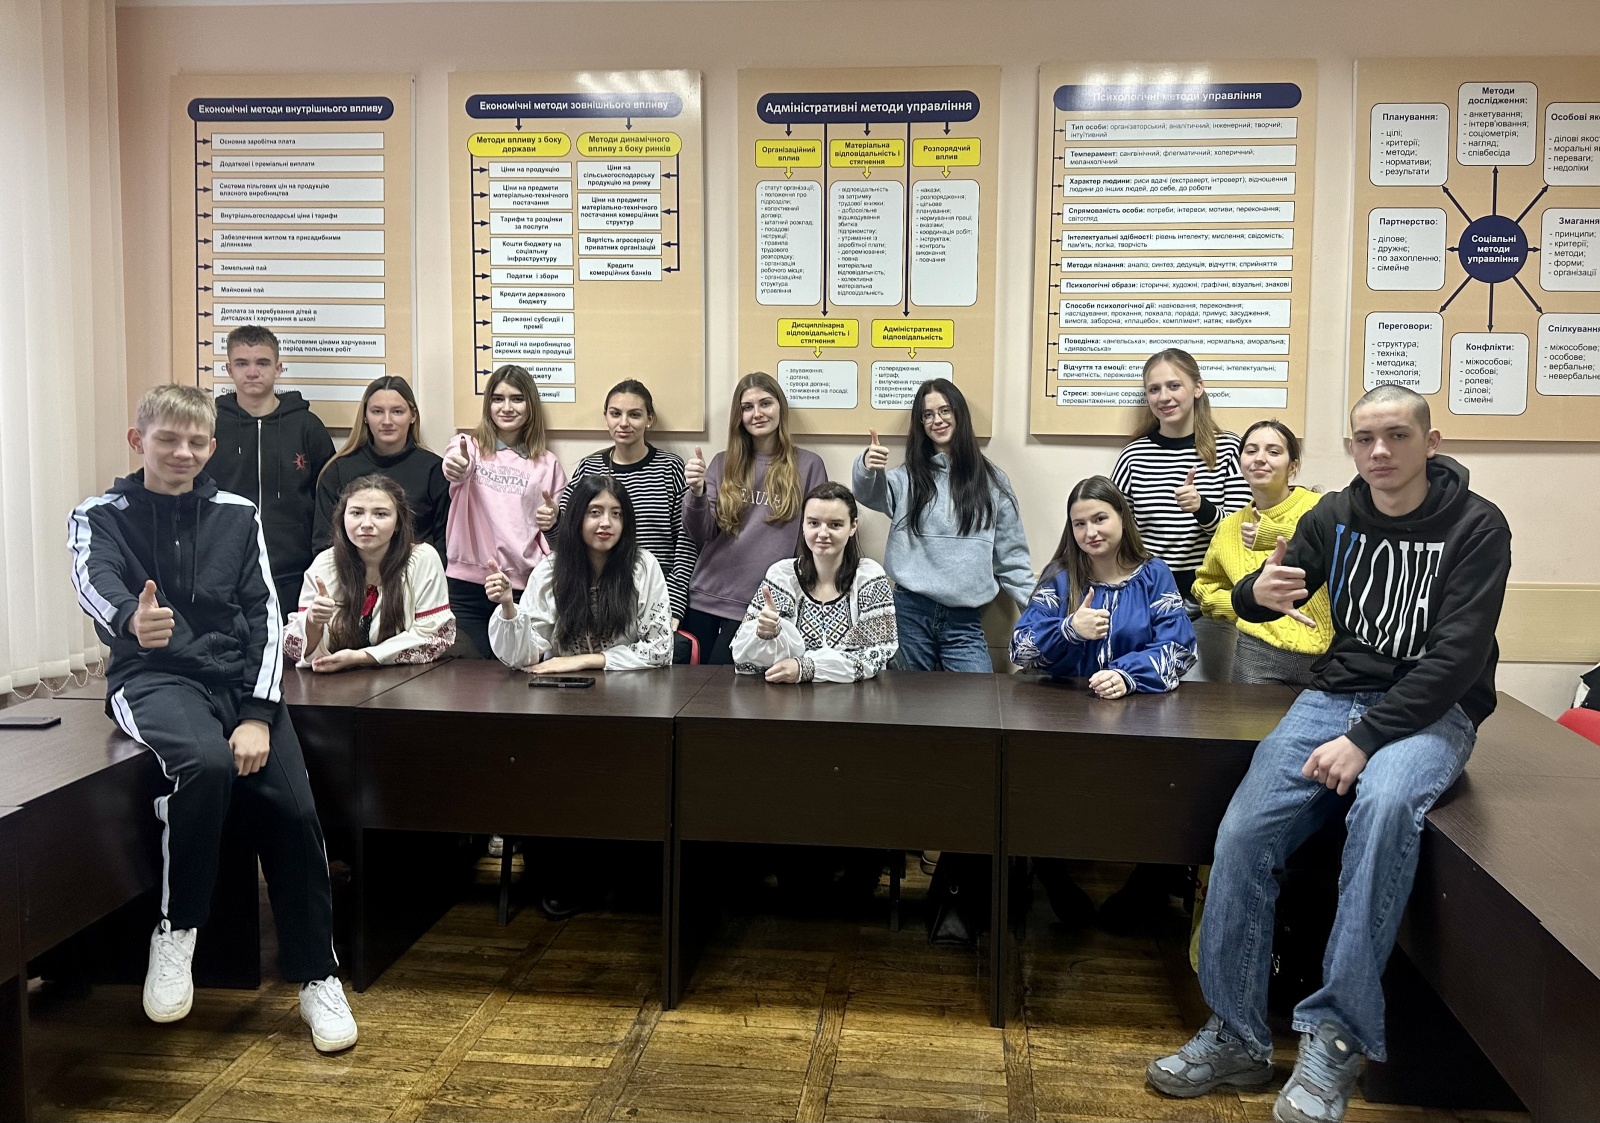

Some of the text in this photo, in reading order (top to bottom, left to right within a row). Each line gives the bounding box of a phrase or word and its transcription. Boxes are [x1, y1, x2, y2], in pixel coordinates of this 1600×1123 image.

[1481, 87, 1515, 95] Методи
[1093, 90, 1262, 102] Психологічні методи управління
[1467, 97, 1528, 105] дослідження:
[198, 104, 383, 115] Економічні методи внутрішнього впливу
[479, 101, 668, 110] Економічні методи зовнішнього впливу
[765, 100, 972, 114] Адміністративні методи управління
[1382, 113, 1438, 122] Планування:
[1468, 120, 1529, 128] інтерв'ювання;
[1386, 129, 1403, 138] цілі;
[1468, 130, 1519, 138] соціометрія;
[476, 136, 506, 144] Методи
[543, 136, 562, 144] боку
[588, 136, 670, 144] Методи динамічного
[1385, 139, 1420, 147] критерії;
[1553, 135, 1579, 143] ділові
[501, 146, 536, 154] держави
[624, 144, 644, 153] боку
[645, 145, 671, 153] ринків
[761, 146, 816, 154] Організаційний
[844, 142, 890, 150] Матеріальна
[923, 145, 971, 153] Розпорядчий
[1553, 145, 1592, 153] моральні
[834, 150, 897, 158] відповідальність
[1467, 148, 1511, 157] співбесіда
[1379, 218, 1438, 226] Партнерство:
[586, 236, 615, 244] Вартість
[1377, 235, 1407, 243] ділове;
[1471, 235, 1517, 243] Соціальні
[1554, 240, 1589, 248] критерії;
[1477, 246, 1510, 254] методи
[1467, 255, 1519, 264] управління
[1553, 259, 1584, 268] форми;
[1553, 269, 1597, 277] організації
[518, 298, 547, 306] бюджету
[1378, 322, 1433, 331] Переговори:
[1465, 343, 1514, 352] Конфлікти:
[1549, 344, 1600, 352] міжособове;
[1377, 350, 1408, 358] техніка;
[1549, 353, 1586, 361] особове;
[1465, 358, 1513, 366] міжособові;
[1548, 362, 1595, 371] вербальне;
[1464, 367, 1499, 375] особові;
[474, 464, 529, 488] POLENTA!
[1329, 523, 1445, 661] VLONE
